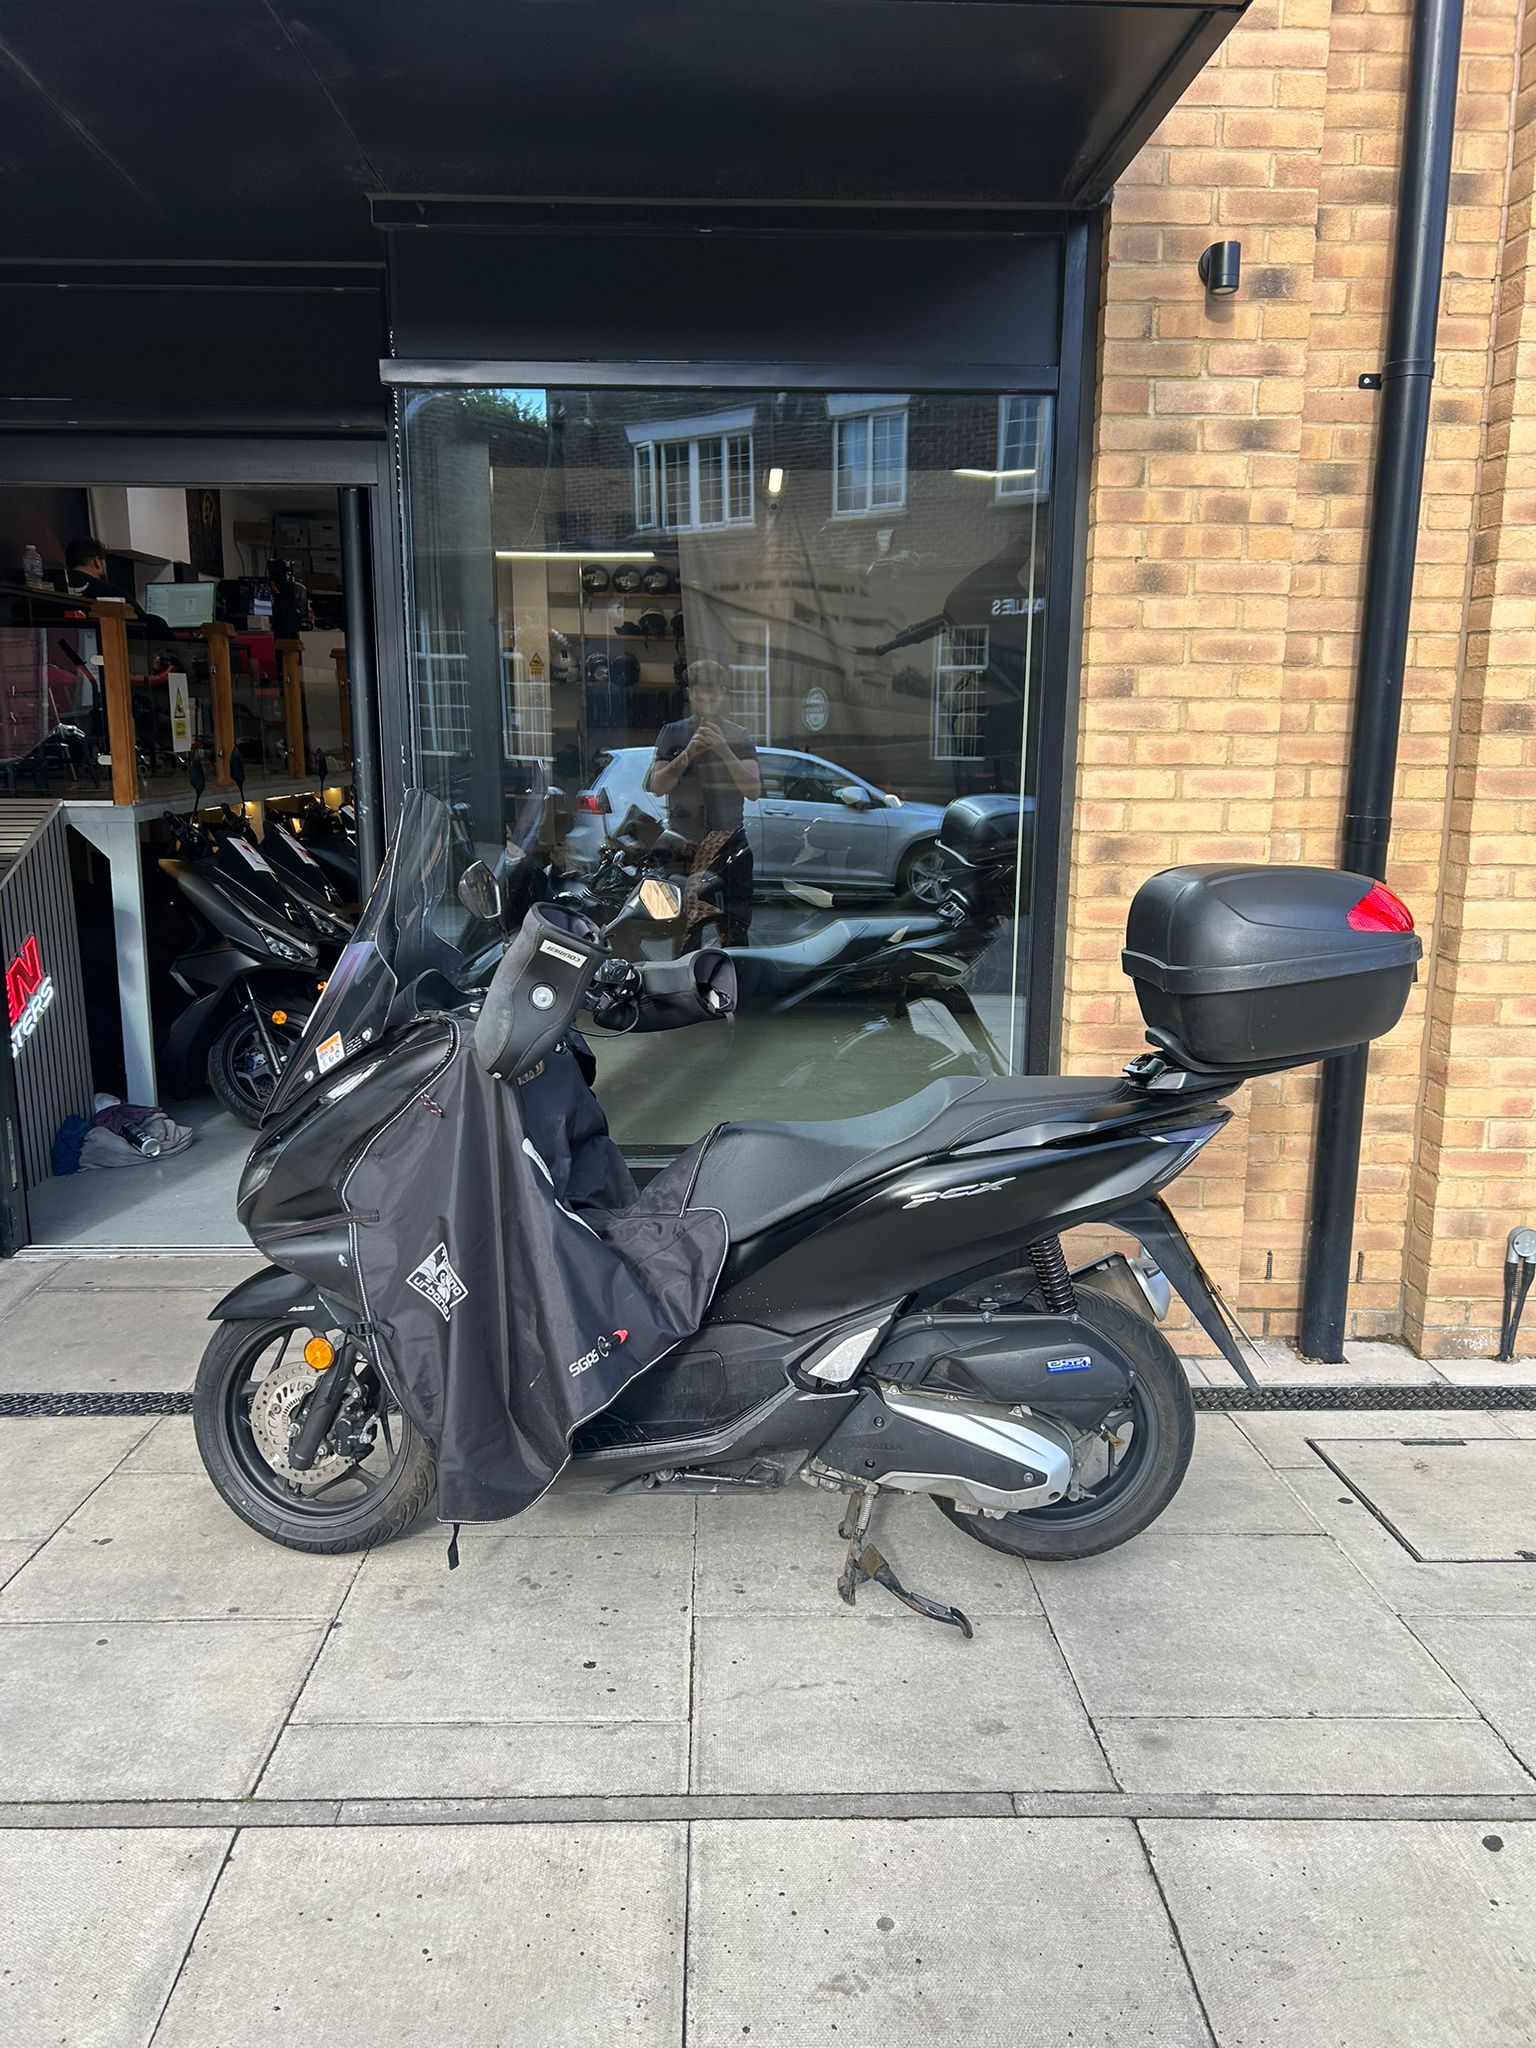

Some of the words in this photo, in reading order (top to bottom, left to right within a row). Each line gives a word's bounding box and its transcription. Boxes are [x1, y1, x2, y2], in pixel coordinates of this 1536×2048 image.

[546, 945, 581, 963] COURIER
[902, 1177, 1016, 1209] PCX
[413, 1276, 450, 1315] urbano
